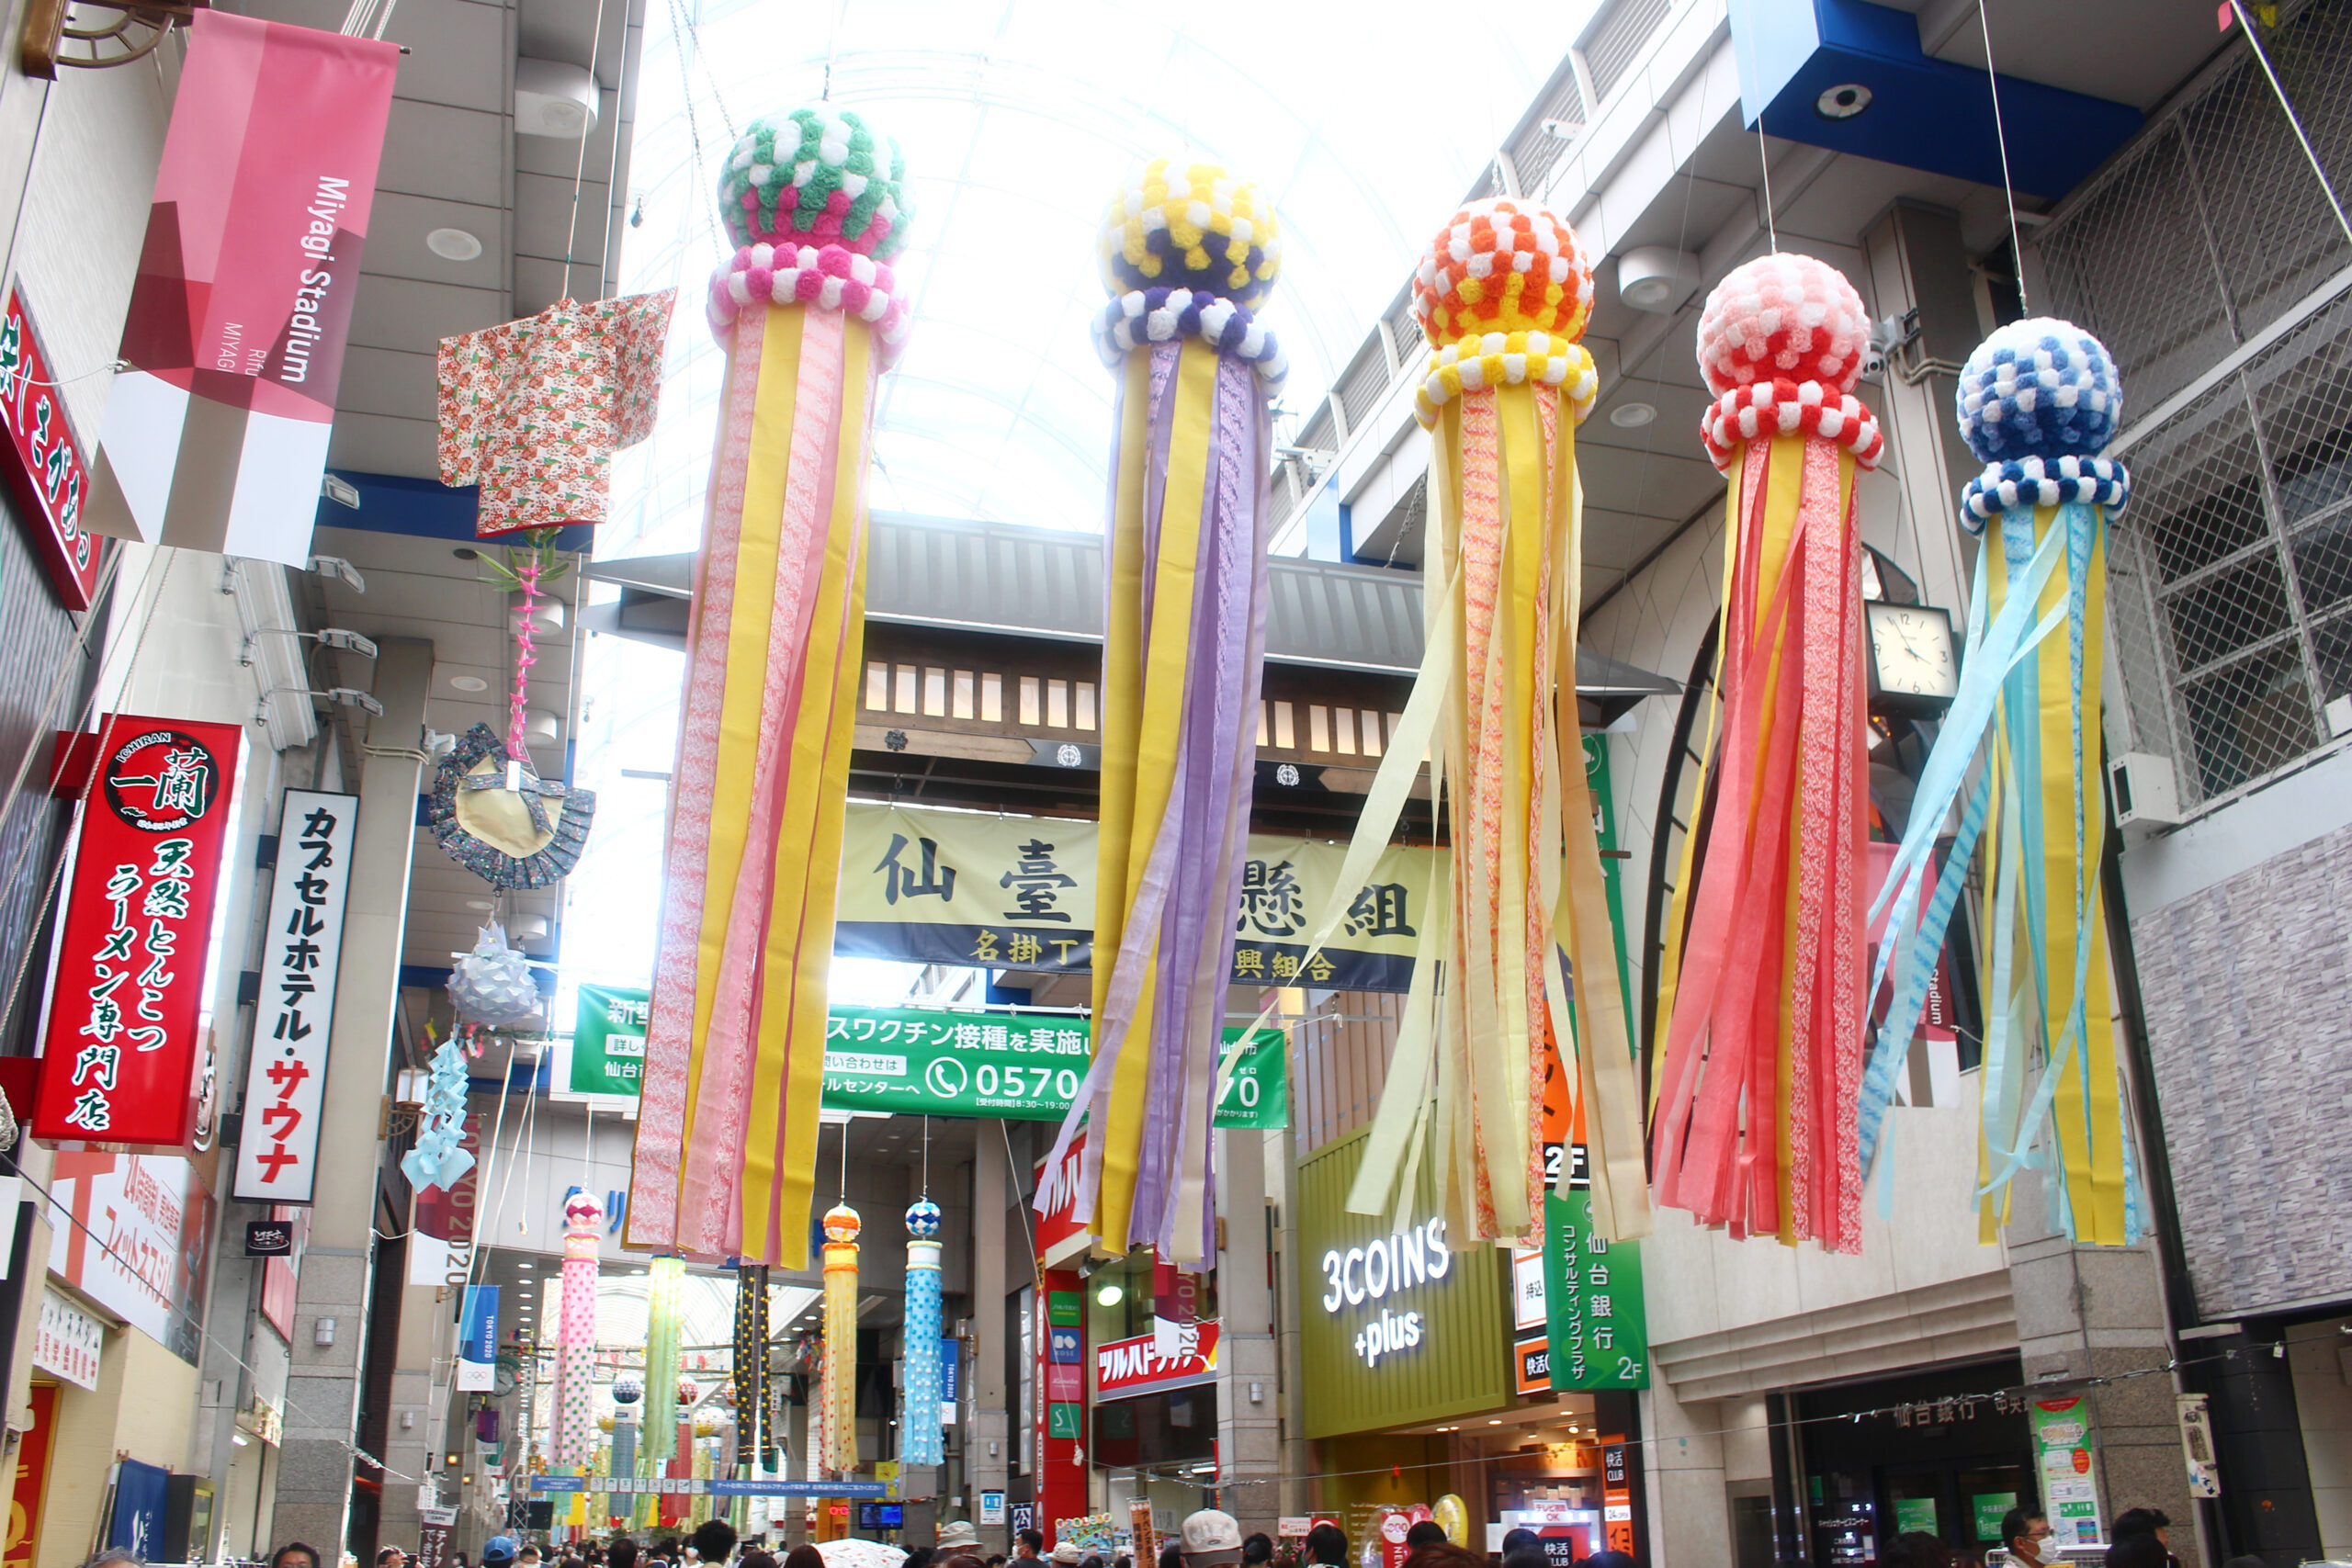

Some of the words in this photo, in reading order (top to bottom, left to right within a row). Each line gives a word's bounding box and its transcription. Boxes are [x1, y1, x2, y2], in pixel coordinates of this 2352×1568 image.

[300, 175, 350, 262] Miyagi
[216, 321, 243, 373] MIYAGI
[280, 268, 332, 383] Stadium
[244, 348, 267, 377] Rifu
[1900, 612, 1910, 626] 12
[1939, 649, 1949, 663] 3
[1912, 680, 1921, 694] 6
[116, 732, 171, 763] ICHIRAN
[110, 747, 209, 818] 一蘭
[128, 837, 194, 1053] 天然とんこつ
[969, 929, 1093, 967] 名掛丁
[65, 863, 143, 1132] ラーメン専門店
[613, 1038, 646, 1053] 詳し
[823, 1077, 921, 1097] ルセンターへ
[976, 1063, 1080, 1100] 0570
[450, 1114, 483, 1208] TOYO
[445, 1215, 474, 1287] 2020
[1323, 1216, 1450, 1314] 3COINS
[1563, 1224, 1586, 1381] コンサルティングプラザ
[1586, 1232, 1614, 1350] 仙台銀行
[483, 1341, 493, 1359] 2020
[485, 1314, 495, 1341] TOKYO
[1178, 1304, 1198, 1357] 2020
[1355, 1307, 1420, 1369] +plus
[1617, 1356, 1643, 1380] 2F
[1550, 1557, 1569, 1567] LUB
